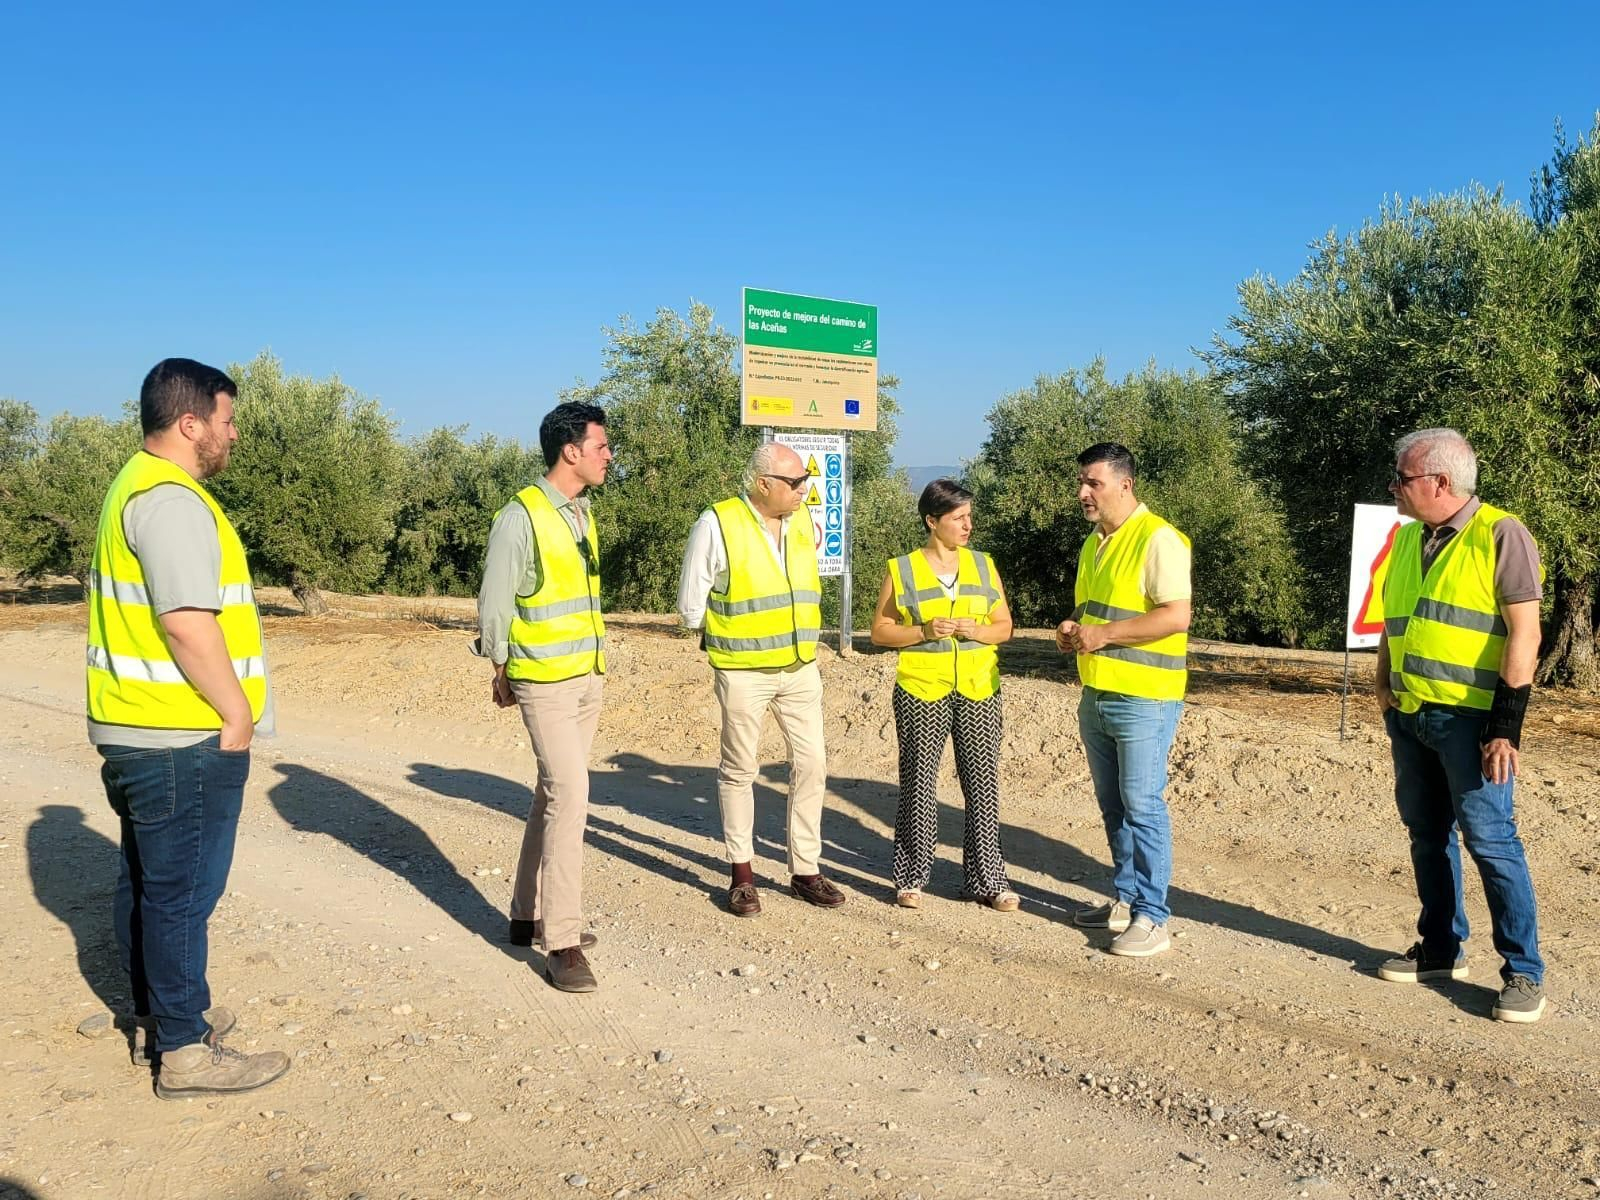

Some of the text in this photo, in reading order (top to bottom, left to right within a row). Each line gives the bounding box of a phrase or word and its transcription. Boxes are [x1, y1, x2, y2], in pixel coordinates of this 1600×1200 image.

[748, 304, 866, 329] Proyecto de mejora del camino de
[748, 319, 787, 333] las Aceñas
